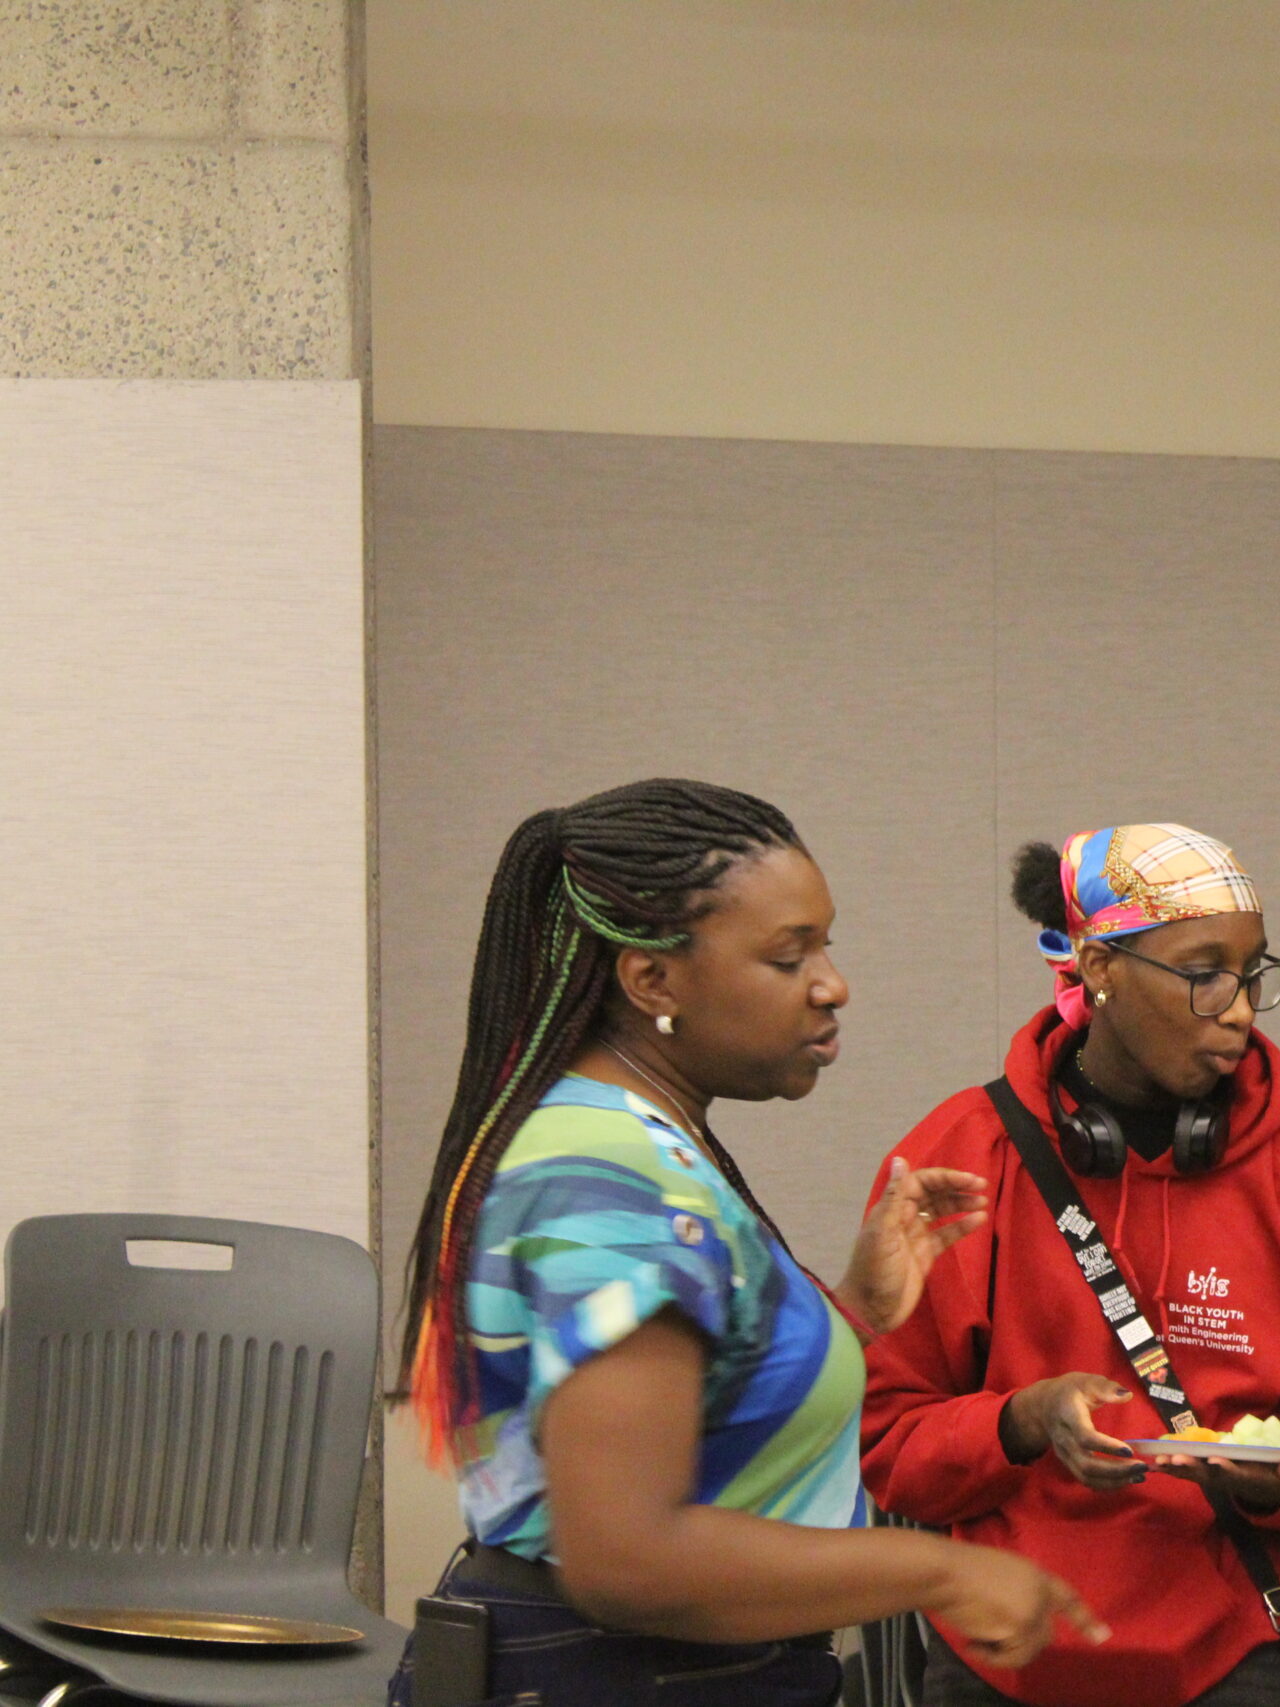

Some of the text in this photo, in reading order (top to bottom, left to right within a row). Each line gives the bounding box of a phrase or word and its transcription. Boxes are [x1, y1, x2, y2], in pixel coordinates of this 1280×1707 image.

[1168, 1302, 1244, 1321] BLACK YOUTH
[1183, 1315, 1227, 1330] IN STEM
[1168, 1324, 1249, 1344] mith Engineering
[1155, 1333, 1165, 1342] at
[1168, 1333, 1205, 1347] Queen's
[1206, 1340, 1255, 1356] University
